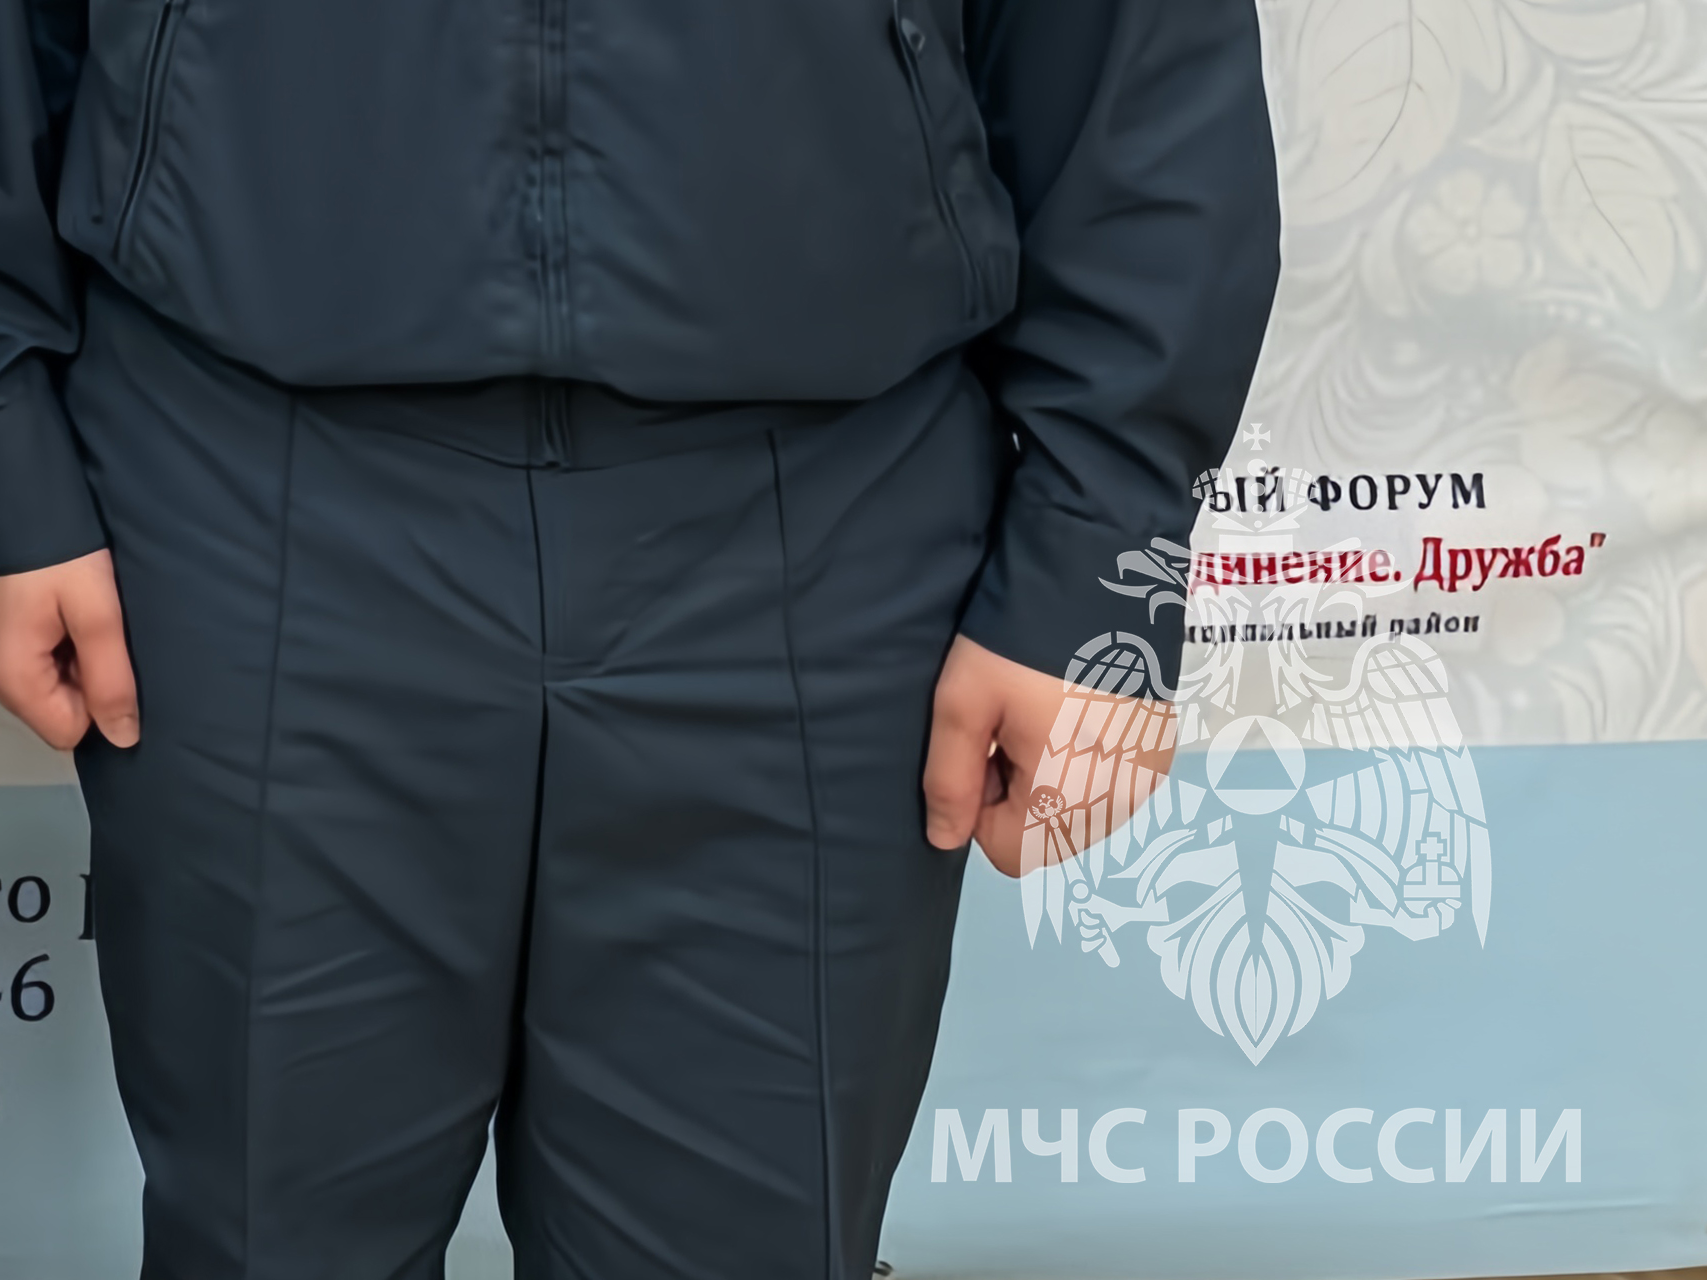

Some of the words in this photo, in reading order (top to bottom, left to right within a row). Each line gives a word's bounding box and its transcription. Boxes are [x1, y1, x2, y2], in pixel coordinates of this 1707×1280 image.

[1208, 467, 1286, 513] ЫЙ
[1308, 473, 1487, 511] ФОРУМ
[1191, 549, 1402, 597] динение.
